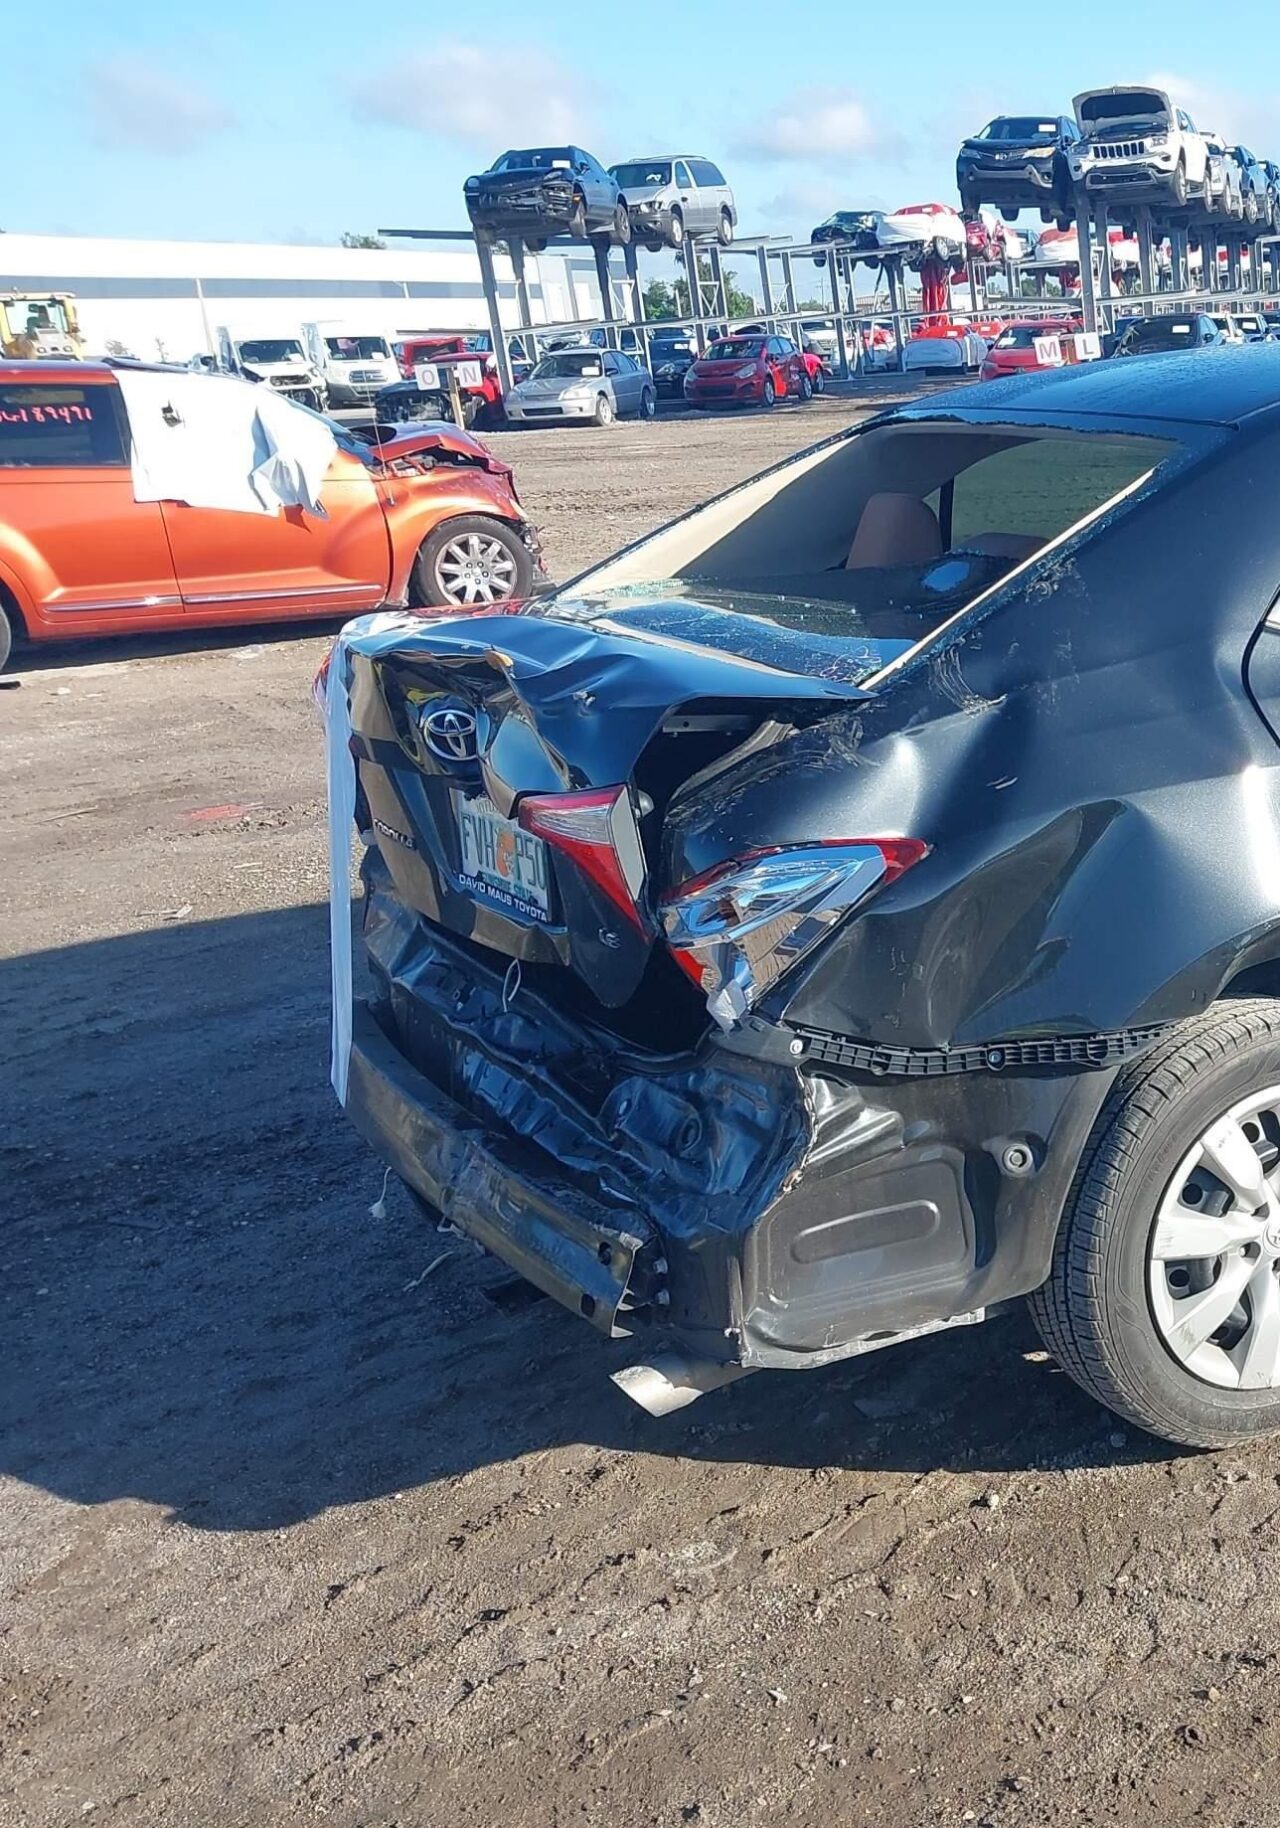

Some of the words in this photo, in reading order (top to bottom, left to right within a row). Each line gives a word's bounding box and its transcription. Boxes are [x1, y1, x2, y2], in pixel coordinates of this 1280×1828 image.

[1039, 341, 1058, 360] M
[1082, 338, 1095, 355] L
[421, 369, 435, 386] O
[461, 366, 478, 383] N
[460, 811, 496, 872] FVH
[459, 873, 486, 893] DAVID
[487, 885, 512, 906] MAUS
[513, 898, 548, 923] TOYOTA
